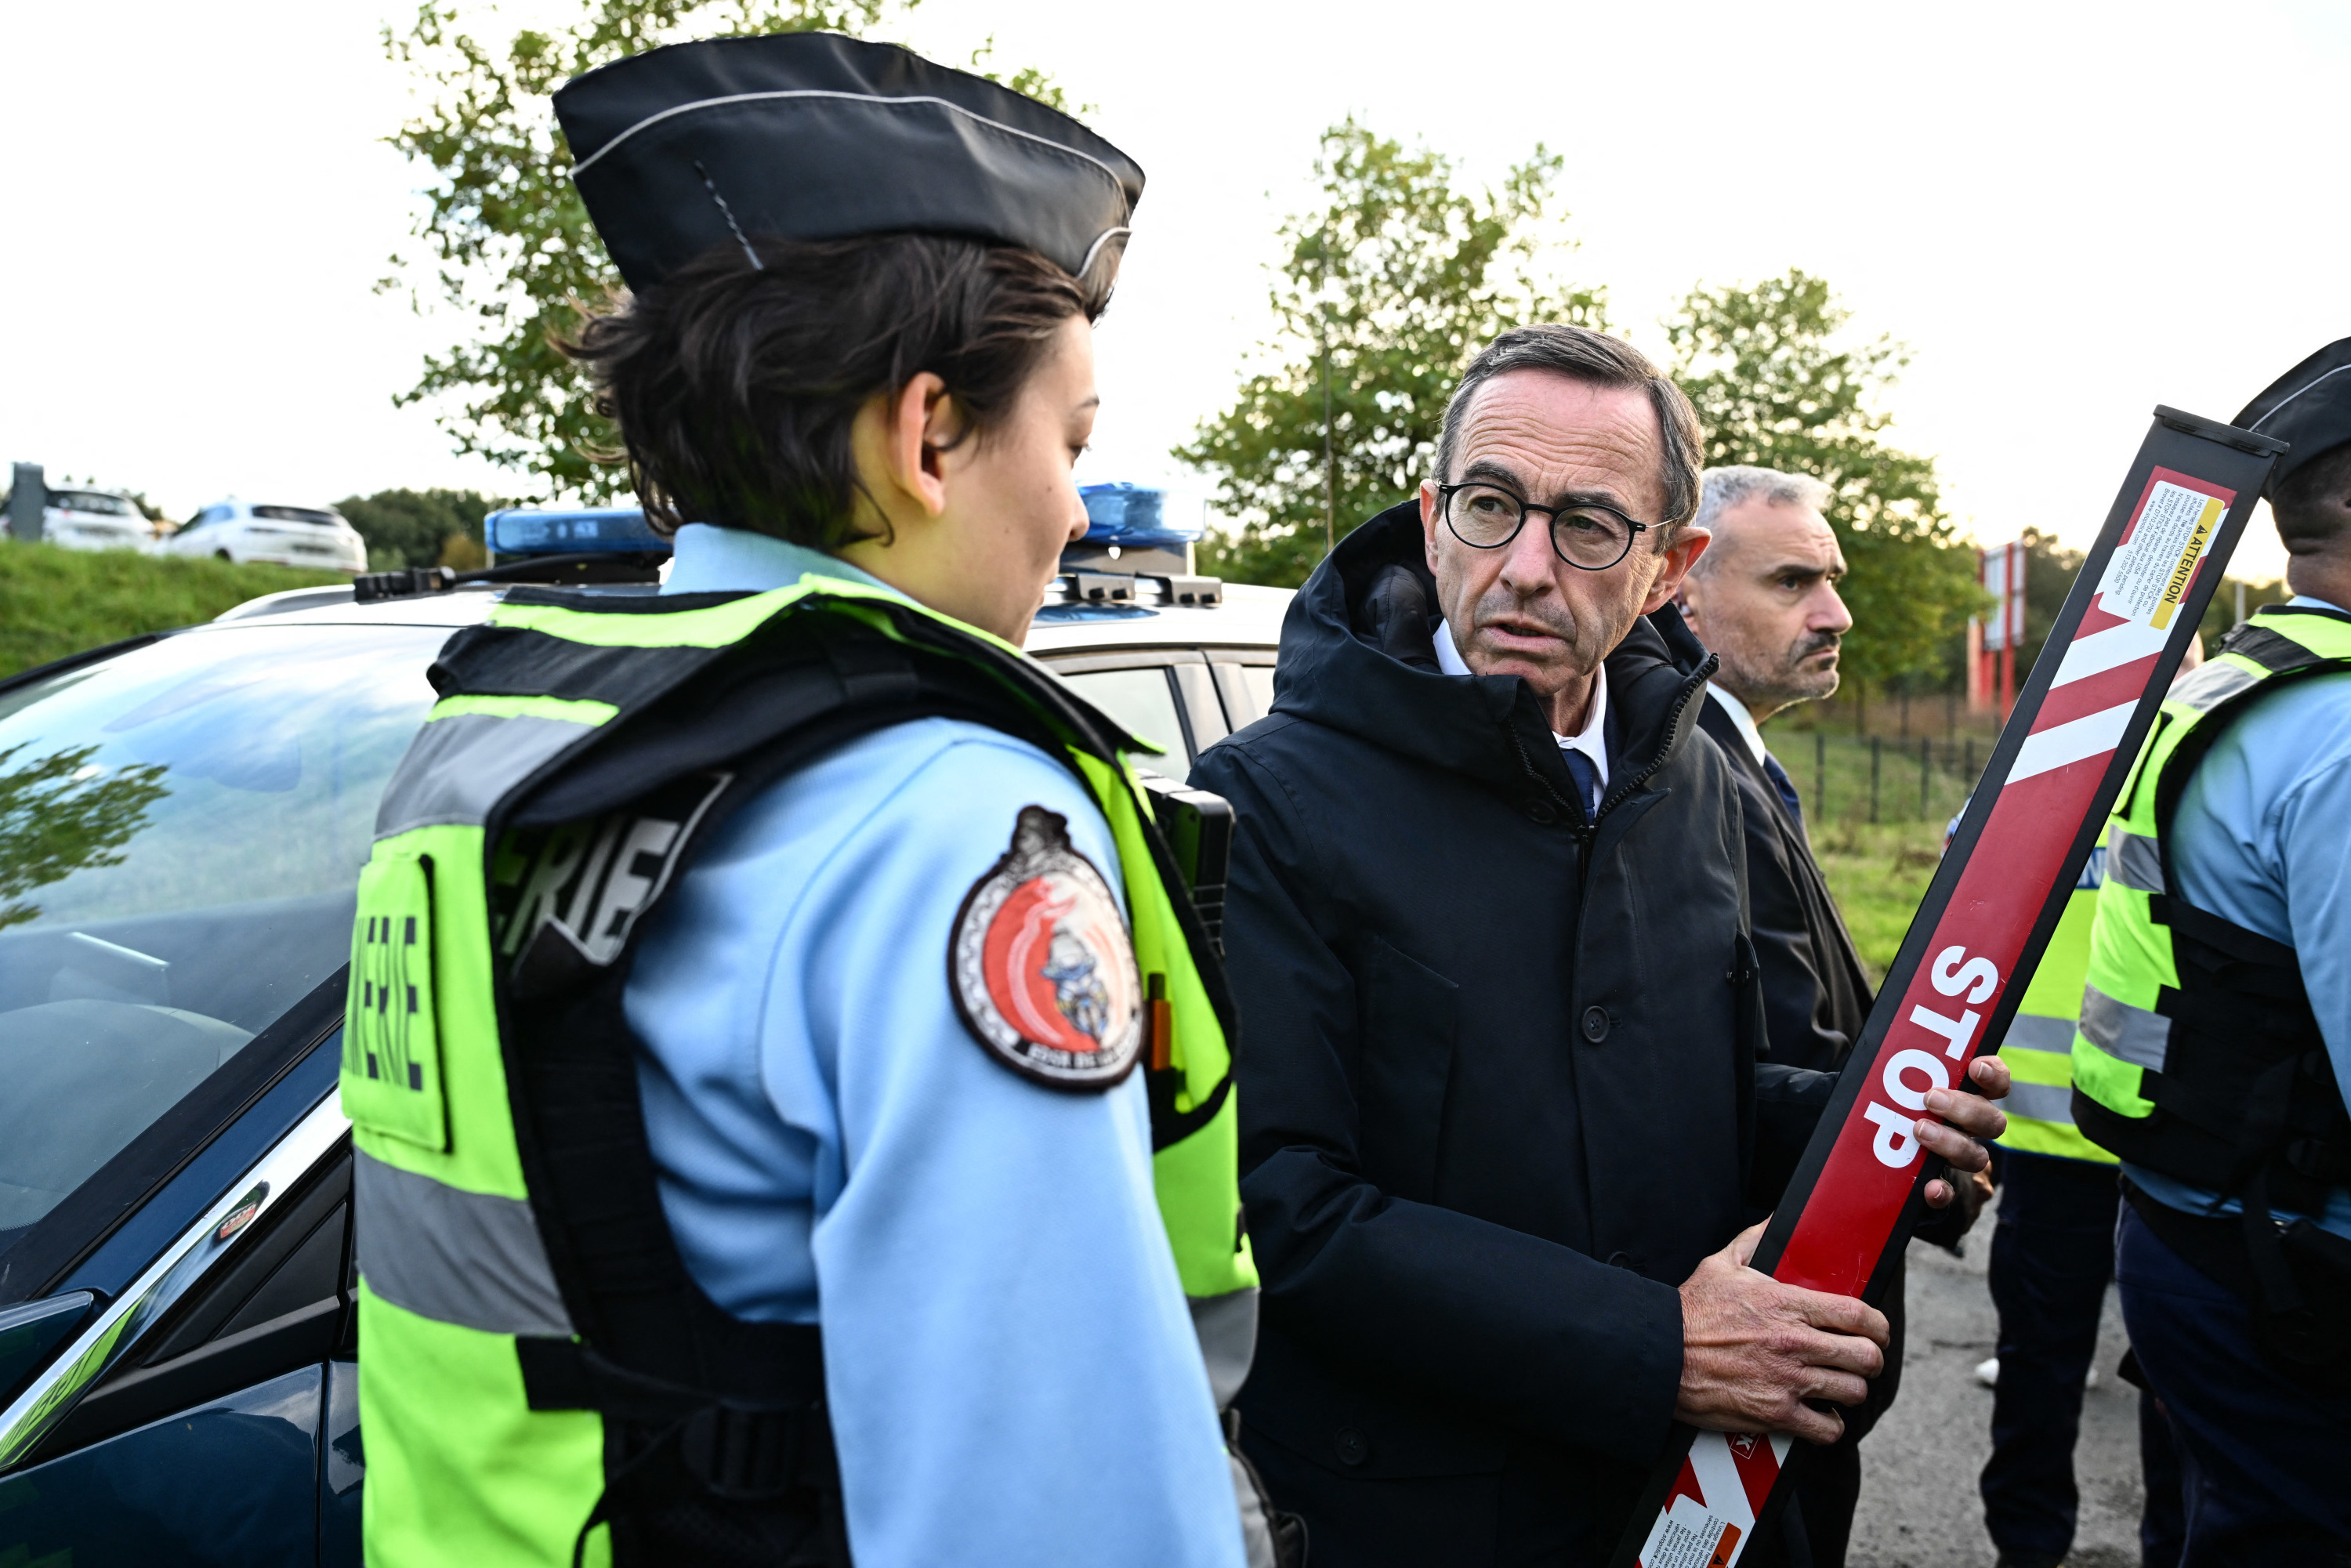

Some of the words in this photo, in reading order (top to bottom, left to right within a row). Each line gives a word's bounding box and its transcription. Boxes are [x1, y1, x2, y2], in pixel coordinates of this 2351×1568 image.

[2159, 488, 2170, 504] Brevet
[2180, 495, 2191, 514] pousser
[2197, 499, 2205, 508] Les
[2164, 498, 2173, 514] STOP
[2168, 493, 2183, 517] N'essayez
[2132, 501, 2155, 545] www.stopstick.com
[2155, 514, 2165, 531] STICK
[2189, 509, 2200, 525] herses
[2168, 523, 2178, 536] dards
[2173, 527, 2183, 544] jamais
[2182, 526, 2192, 541] STOP
[2157, 545, 2168, 561] travers
[2165, 545, 2175, 559] tordre
[2173, 541, 2185, 558] STICK
[2126, 556, 2136, 575] patents
[2134, 563, 2142, 574] USA
[2160, 559, 2175, 586] contiennent
[2164, 537, 2202, 604] ATTENTION
[2114, 570, 2123, 583] 5500
[2147, 570, 2155, 584] carter
[2155, 568, 2165, 583] STOP
[2128, 586, 2138, 604] d'ouvrir
[2146, 584, 2157, 600] STICK
[2146, 596, 2157, 615] pointes
[1864, 945, 1998, 1168] STOP
[1667, 1524, 1680, 1547] véhicules
[1700, 1515, 1713, 1539] sérieuses
[1713, 1522, 1725, 1541] L'usage
[1671, 1534, 1682, 1552] jamais
[1658, 1552, 1666, 1565] deux
